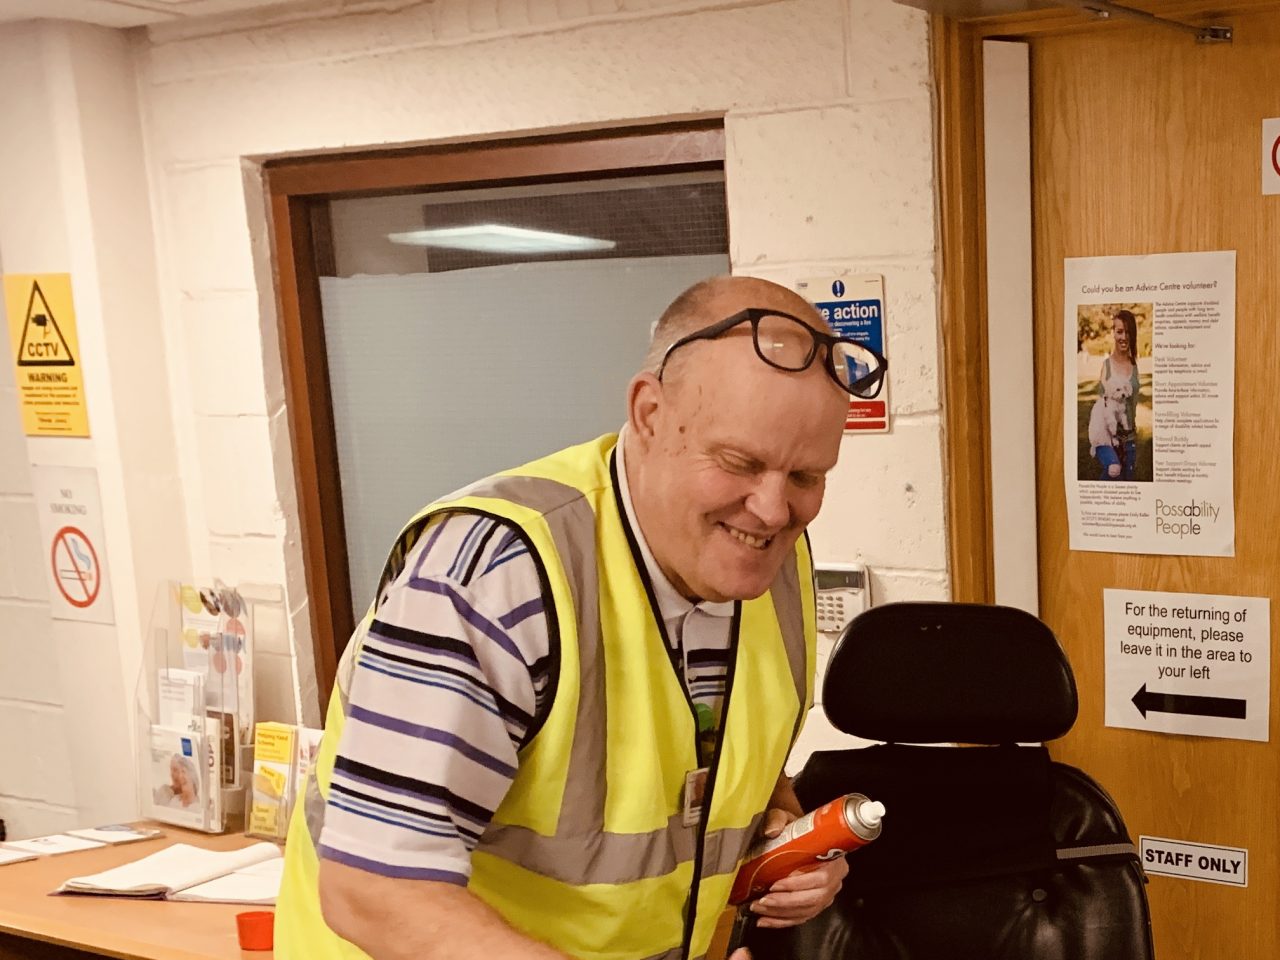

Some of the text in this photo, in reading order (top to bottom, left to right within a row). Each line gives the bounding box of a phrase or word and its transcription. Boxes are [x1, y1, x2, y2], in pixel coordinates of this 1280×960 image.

[1081, 281, 1218, 295] Could you be an Advice Centre volunteer?
[833, 302, 878, 320] action
[27, 342, 58, 357] CCTV
[27, 373, 68, 383] WARNING
[1155, 498, 1220, 523] Possability
[1155, 517, 1201, 540] People
[1125, 602, 1248, 624] For the returning of
[1127, 623, 1244, 643] equipment, please
[1120, 641, 1252, 663] leave it in the area to
[1158, 665, 1211, 680] your left
[1145, 848, 1242, 875] STAFF ONLY
